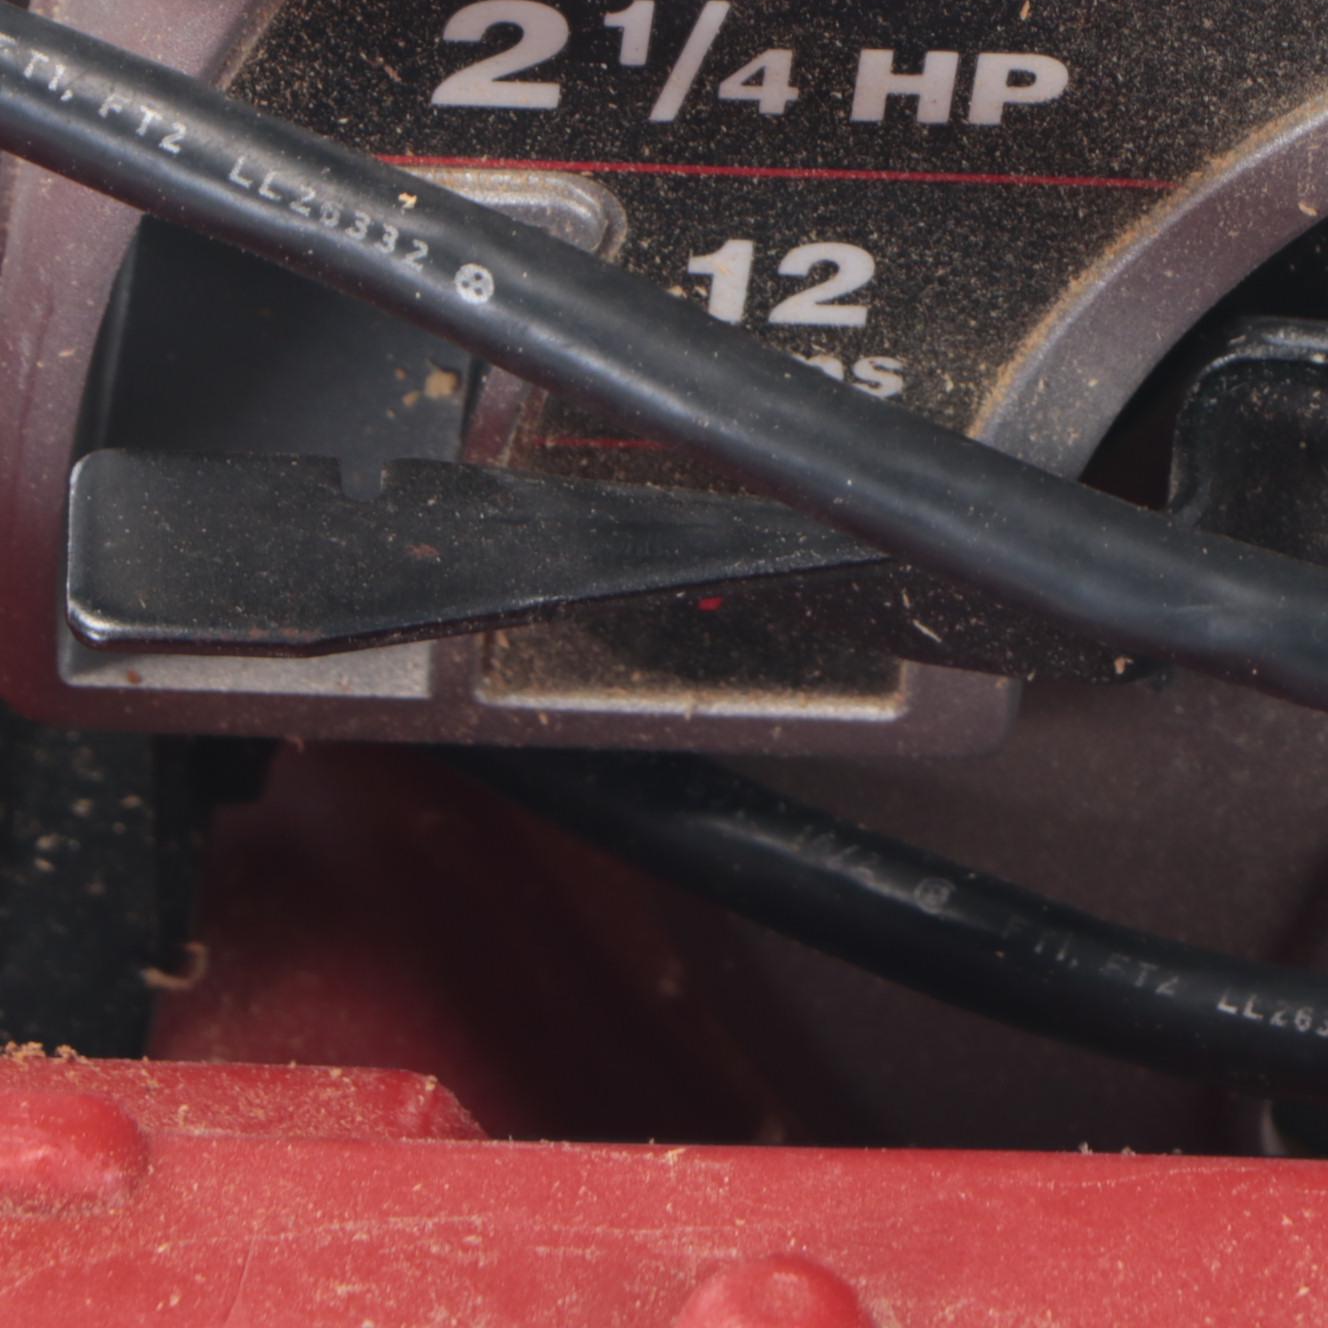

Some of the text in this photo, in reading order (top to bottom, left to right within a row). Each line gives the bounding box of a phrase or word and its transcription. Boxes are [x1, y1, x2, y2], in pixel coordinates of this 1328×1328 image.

[98, 93, 188, 155] FT2
[851, 48, 1069, 127] HP
[687, 236, 878, 329] 12
